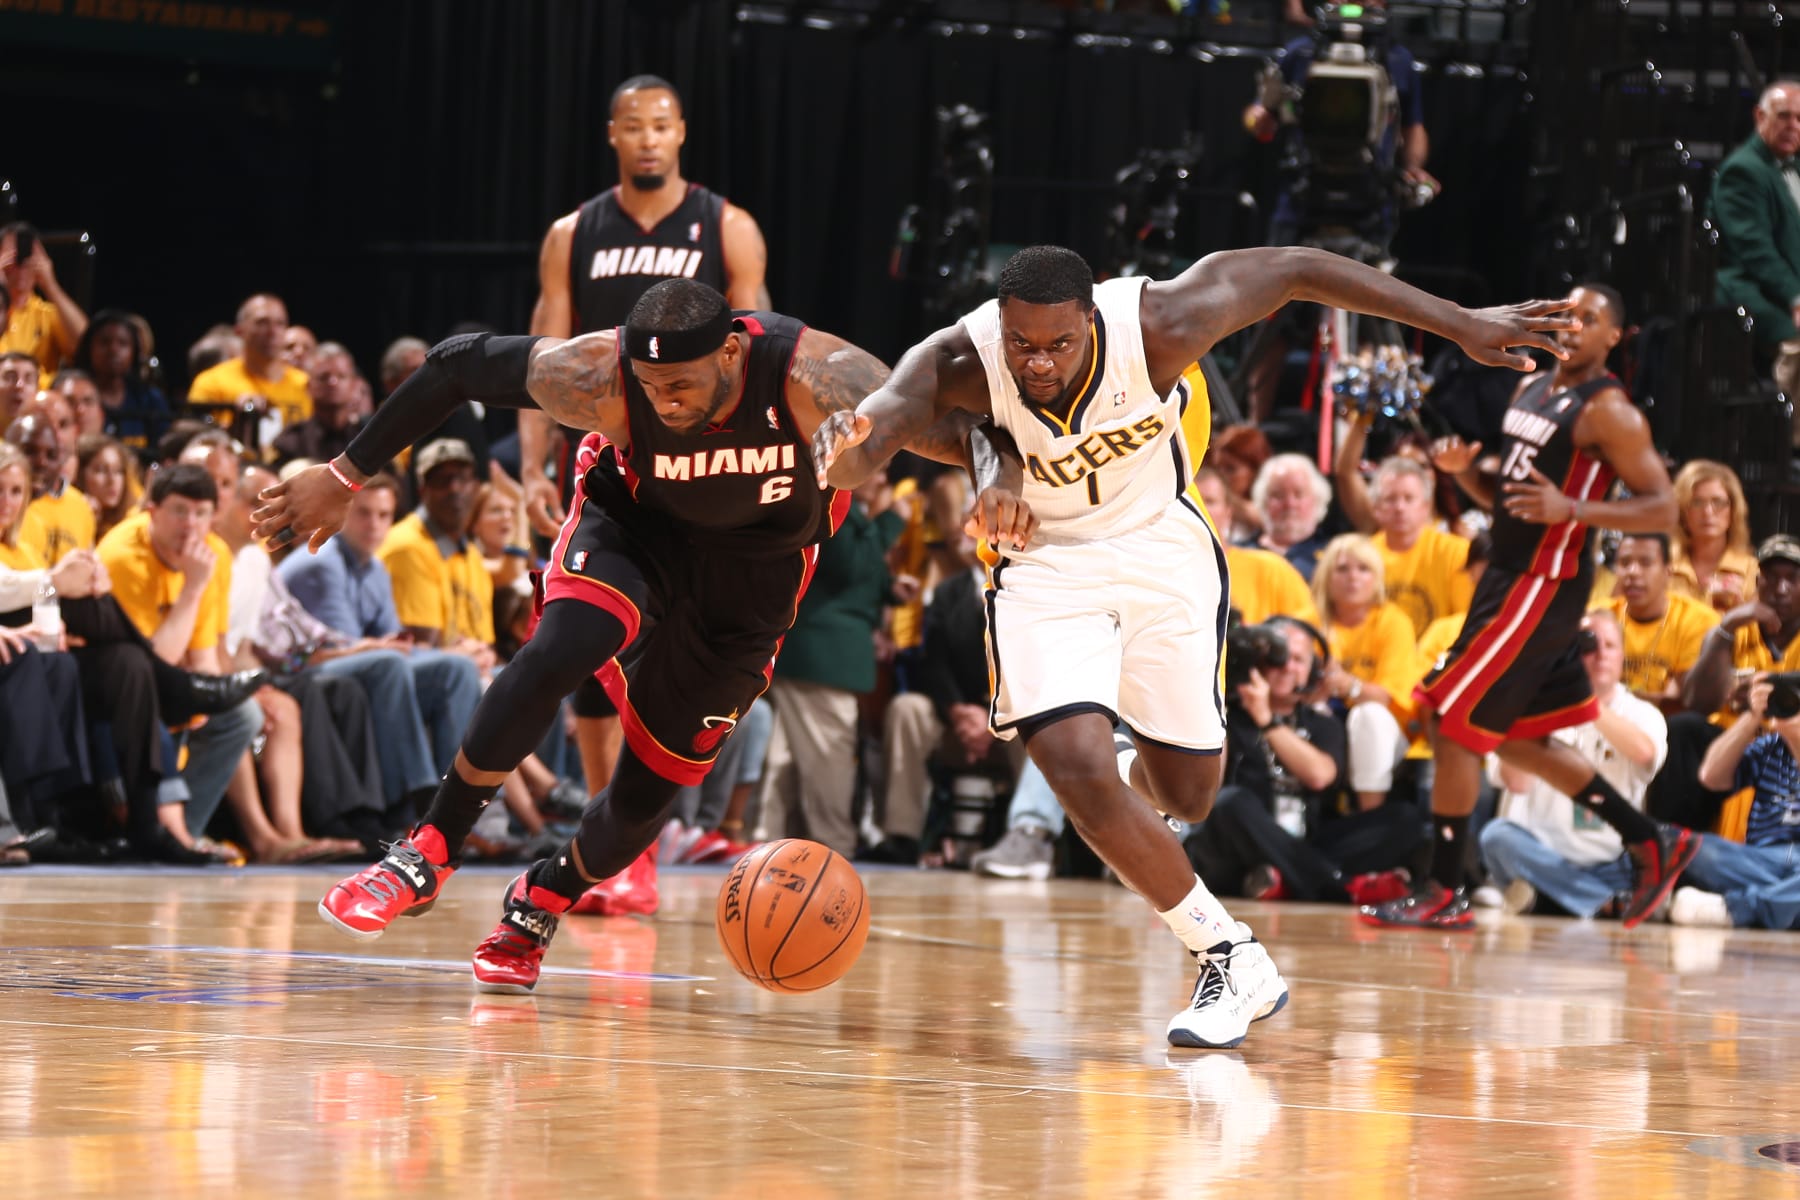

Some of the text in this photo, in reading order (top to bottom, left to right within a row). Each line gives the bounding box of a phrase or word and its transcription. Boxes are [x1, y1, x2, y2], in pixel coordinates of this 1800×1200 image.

[589, 245, 703, 280] MIAMI
[1502, 407, 1558, 447] MIAMI
[654, 443, 796, 482] MIAMI
[1025, 413, 1165, 488] ACERS
[1502, 441, 1539, 481] 15
[758, 475, 794, 505] 6
[1086, 470, 1101, 506] 1
[725, 850, 760, 923] SPALD
